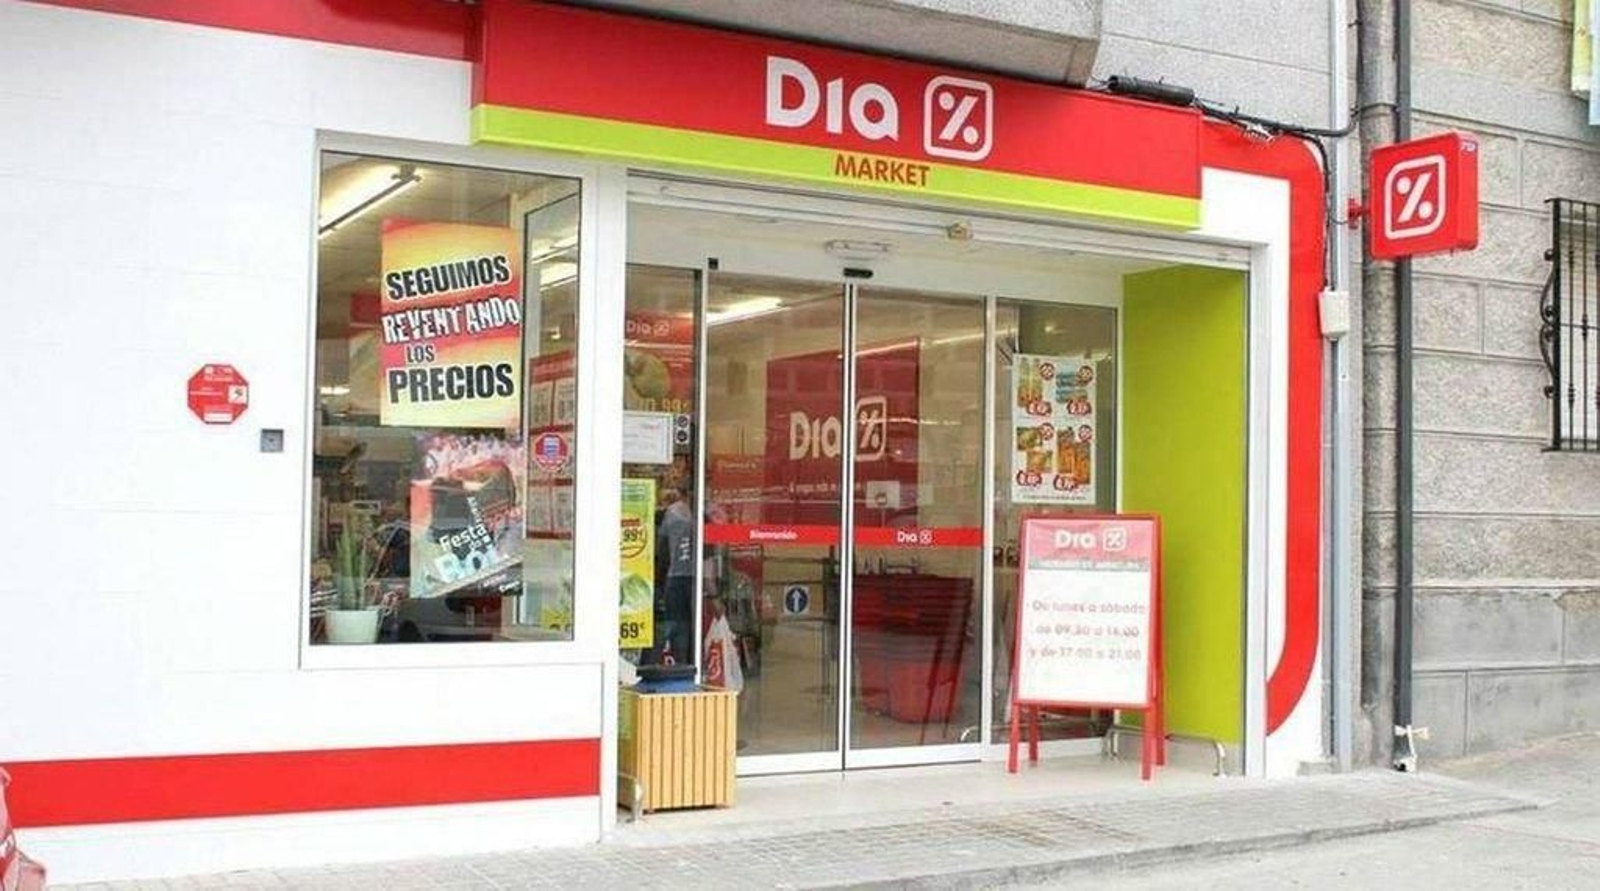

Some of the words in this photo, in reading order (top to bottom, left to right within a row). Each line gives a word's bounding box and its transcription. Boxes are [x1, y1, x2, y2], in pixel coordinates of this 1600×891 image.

[834, 153, 930, 187] MARKET
[386, 255, 510, 300] SEGUIMOS
[406, 344, 435, 363] LOS
[388, 363, 515, 404] PRECIOS
[439, 522, 487, 552] Festa
